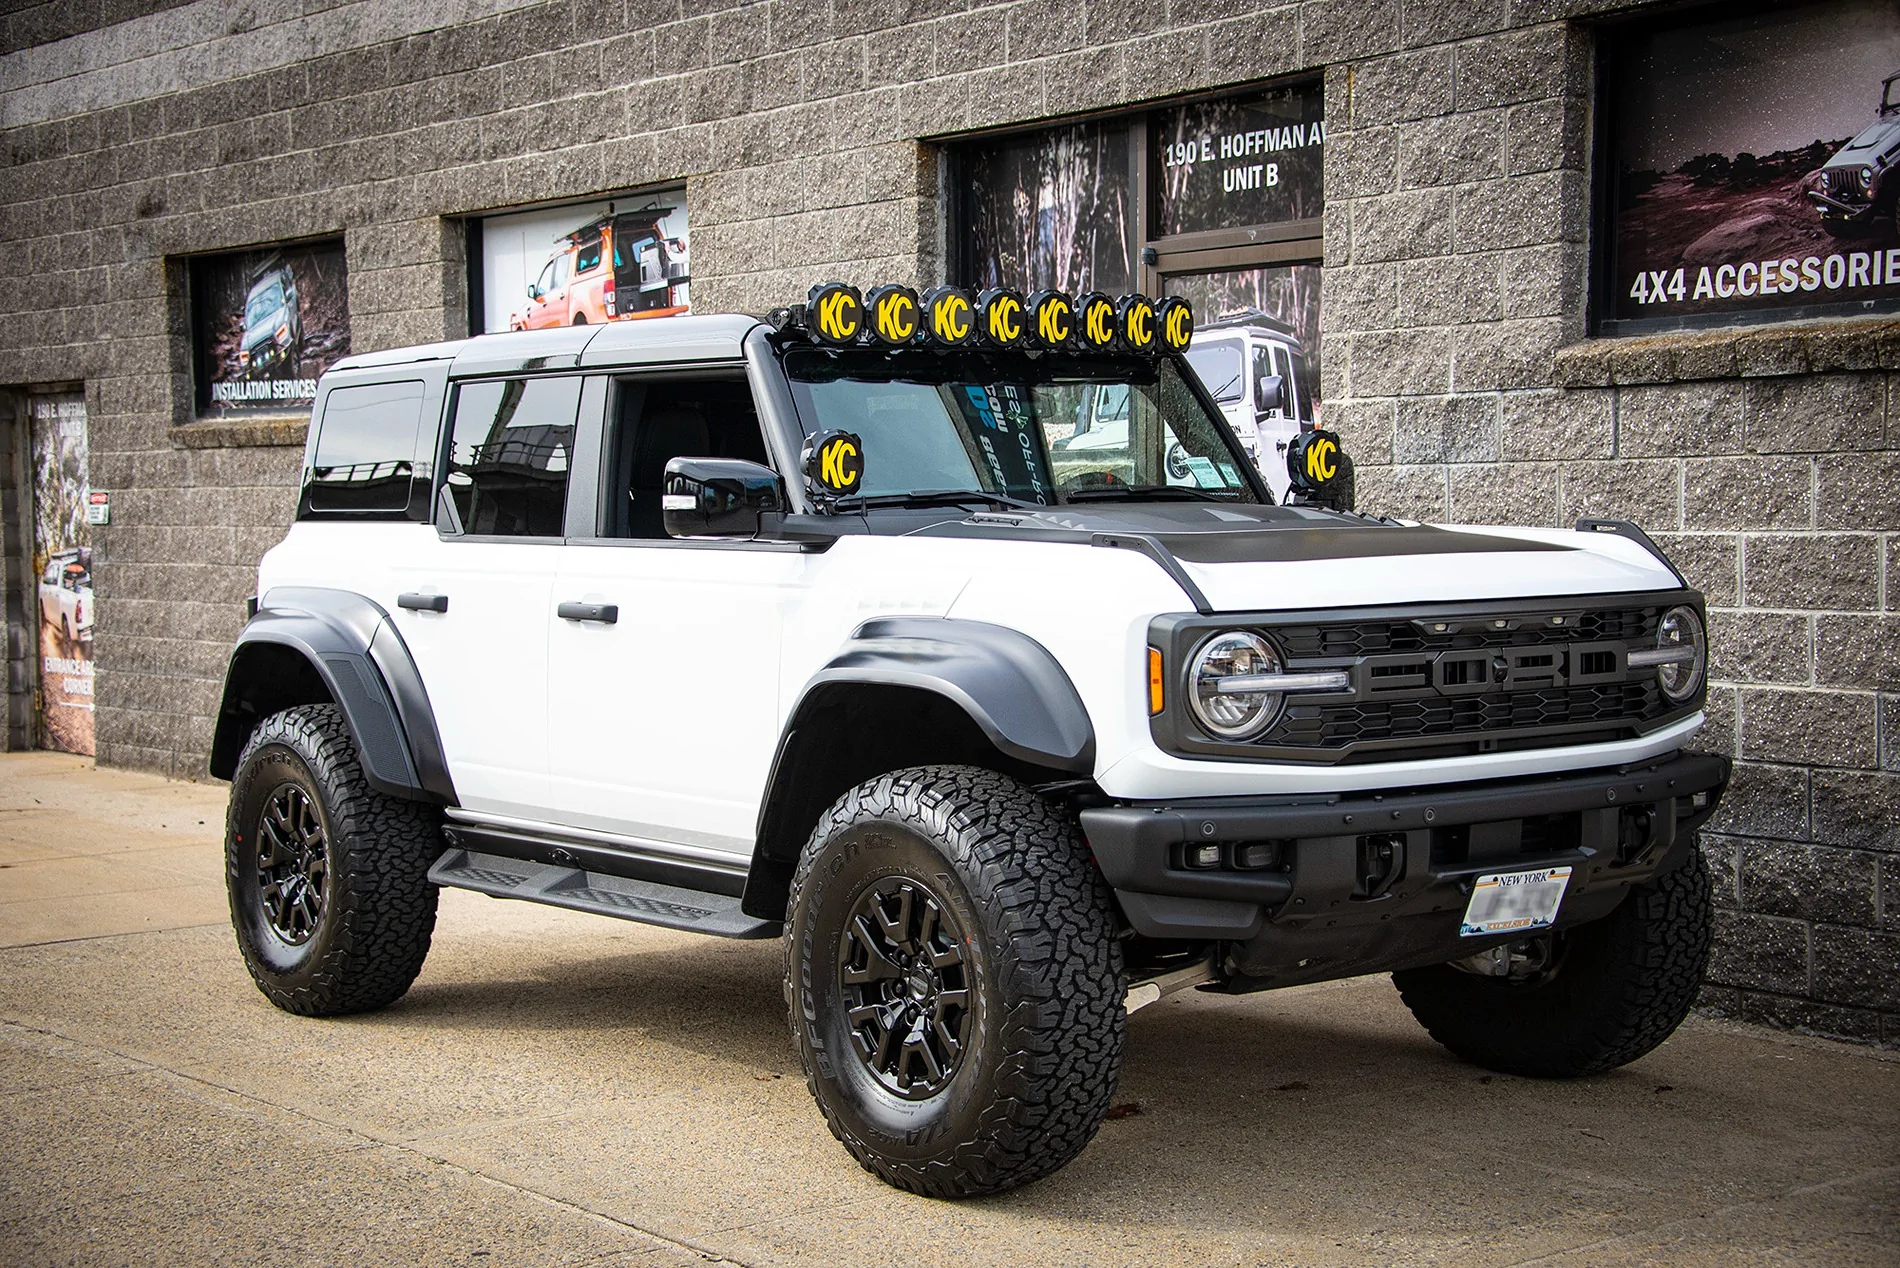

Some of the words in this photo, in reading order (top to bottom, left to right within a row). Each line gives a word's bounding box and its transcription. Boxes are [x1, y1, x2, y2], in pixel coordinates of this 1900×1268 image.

[1166, 141, 1196, 167] 190
[1201, 138, 1216, 162] E.
[1220, 124, 1304, 159] HOFFMAN
[1223, 165, 1264, 192] UNIT
[1266, 163, 1279, 187] B
[1630, 268, 1687, 304] 4X4
[1693, 249, 1900, 300] ACCESSORIE
[820, 292, 856, 339] KC
[878, 293, 913, 340] KC
[934, 295, 968, 341] KC
[990, 297, 1020, 342] KC
[1039, 298, 1068, 343] KC
[1087, 301, 1112, 345] KC
[1127, 303, 1152, 346] KC
[1166, 305, 1190, 348] KC
[212, 380, 271, 400] INSTALLATION
[272, 379, 317, 399] SERVICES
[822, 440, 856, 488] KC
[1307, 439, 1336, 481] KC
[1358, 643, 1626, 700] FORD
[1498, 876, 1523, 887] NEW
[1524, 871, 1549, 884] YORK
[1486, 918, 1531, 931] EXCELSIOR
[802, 841, 859, 1080] BFGoodrich
